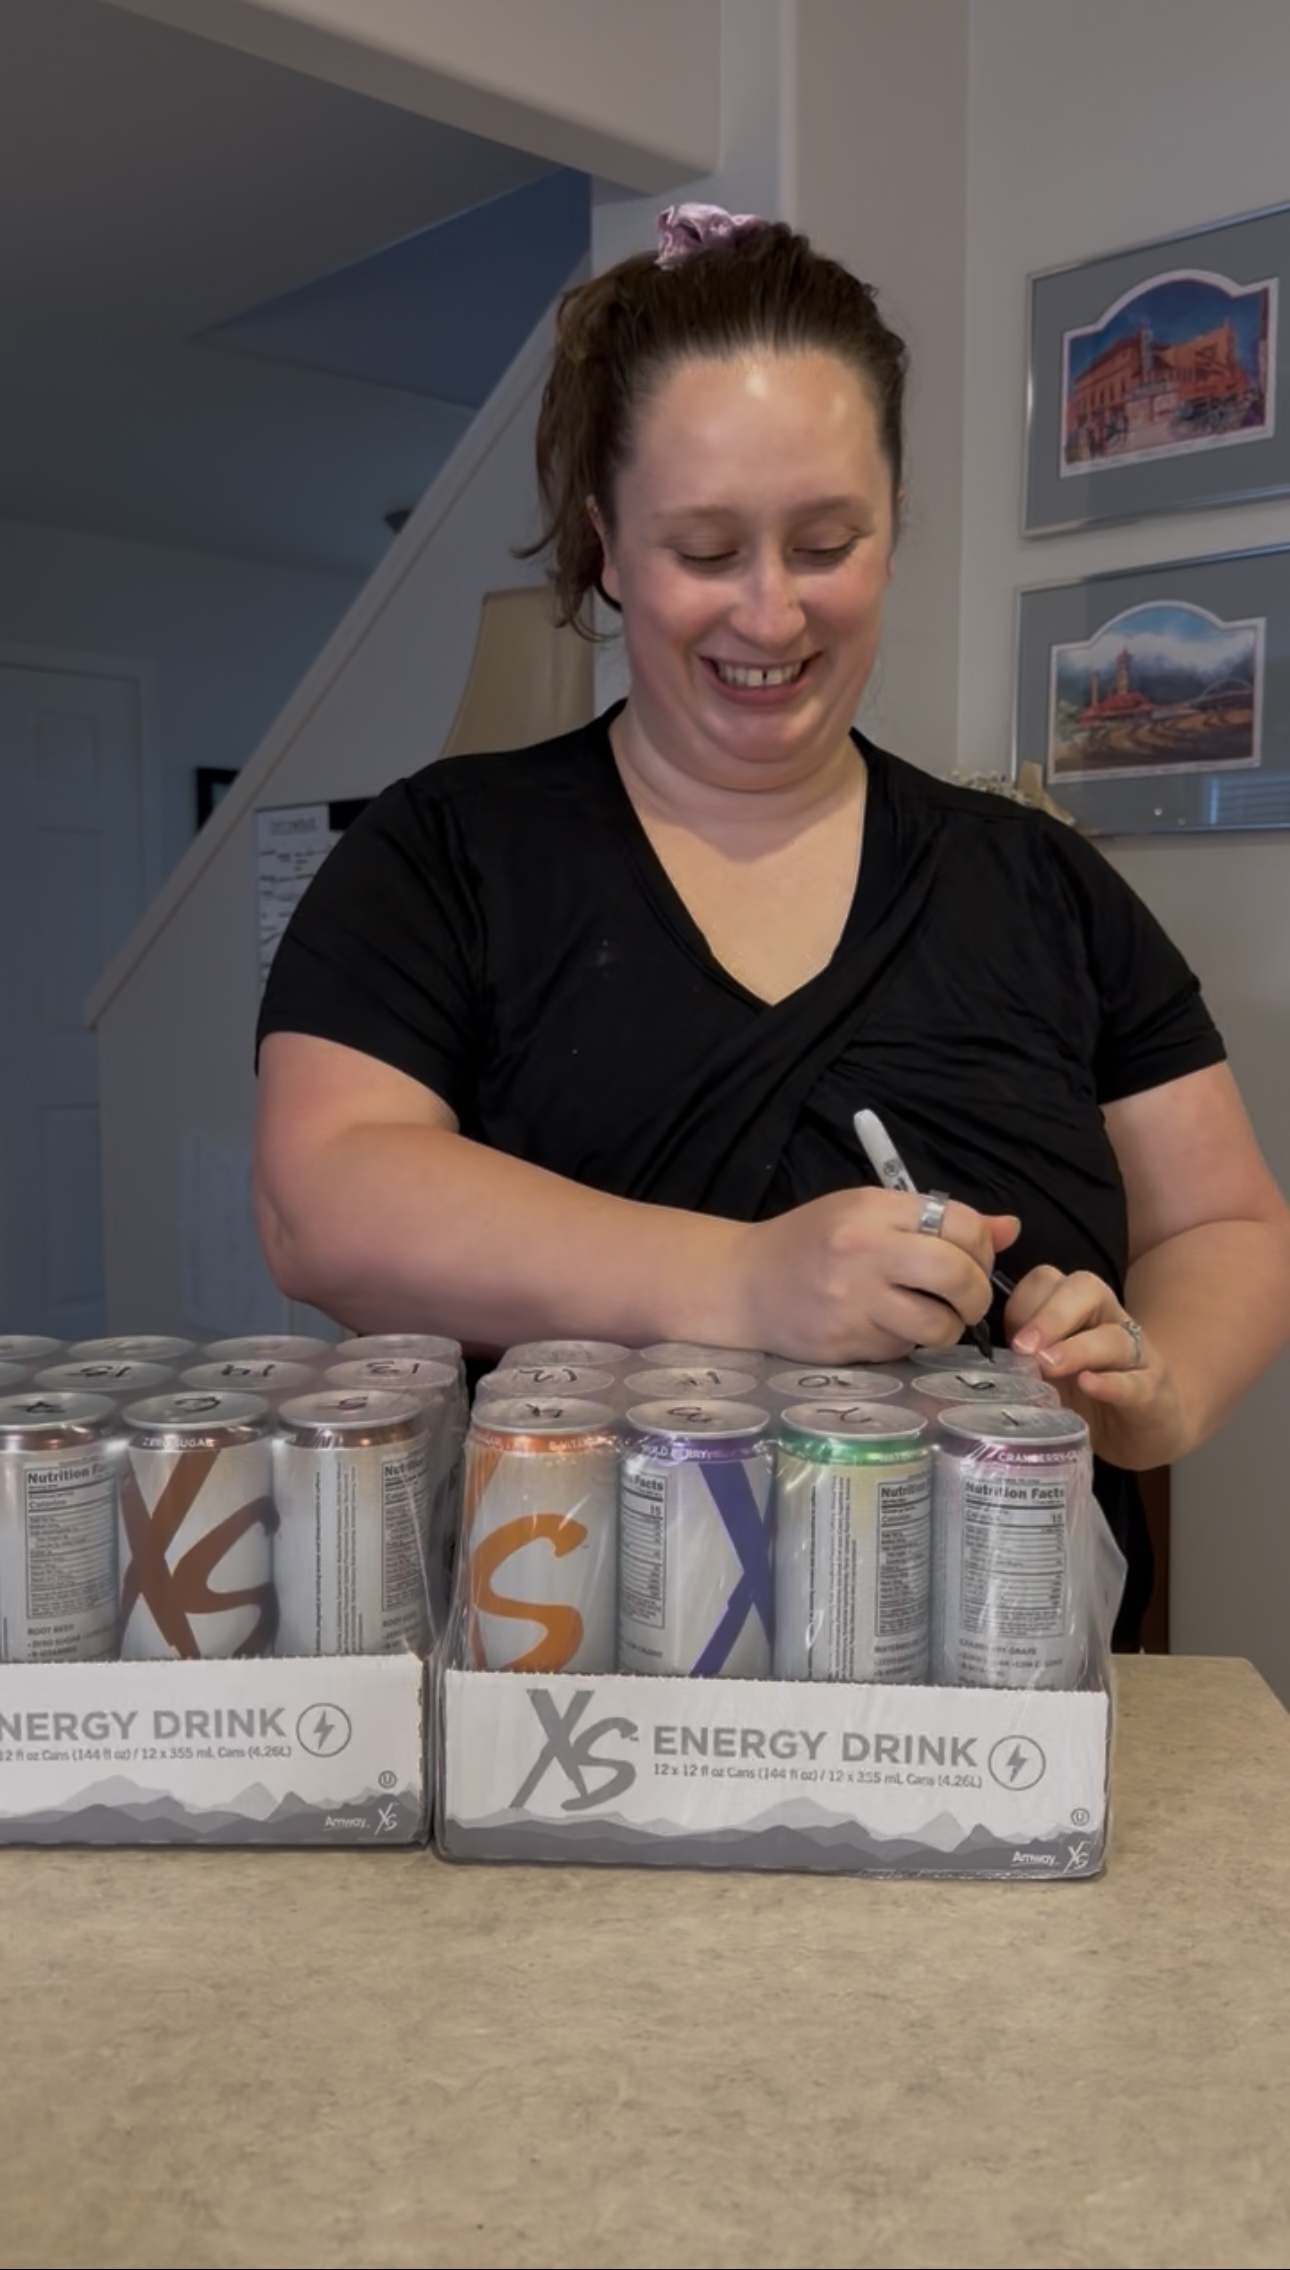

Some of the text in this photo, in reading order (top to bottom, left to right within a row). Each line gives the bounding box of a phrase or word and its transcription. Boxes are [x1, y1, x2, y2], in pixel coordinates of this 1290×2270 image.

[28, 1468, 90, 1484] Nutrition
[634, 1475, 664, 1492] Facts
[964, 1481, 1065, 1500] Nutrition Facts
[153, 1707, 286, 1740] DRINK
[42, 1749, 70, 1761] Cans
[142, 1747, 158, 1760] 12
[160, 1750, 167, 1759] x
[170, 1746, 194, 1759] 355
[218, 1746, 246, 1758] Cans
[508, 1688, 639, 1812] XS
[653, 1725, 979, 1768] ENERGY DRINK
[653, 1763, 670, 1776] 12
[671, 1766, 678, 1776] x
[683, 1764, 698, 1777] 12
[711, 1768, 726, 1778] oz
[727, 1767, 755, 1780] Cans
[758, 1768, 787, 1781] (144
[829, 1770, 844, 1783] 12
[884, 1773, 904, 1785] mL
[906, 1773, 935, 1786] Cans
[938, 1774, 983, 1789] (4.26L)
[324, 1815, 367, 1828] Amway
[374, 1802, 399, 1836] XS
[1011, 1850, 1057, 1867] Amway
[1062, 1840, 1091, 1874] XS
